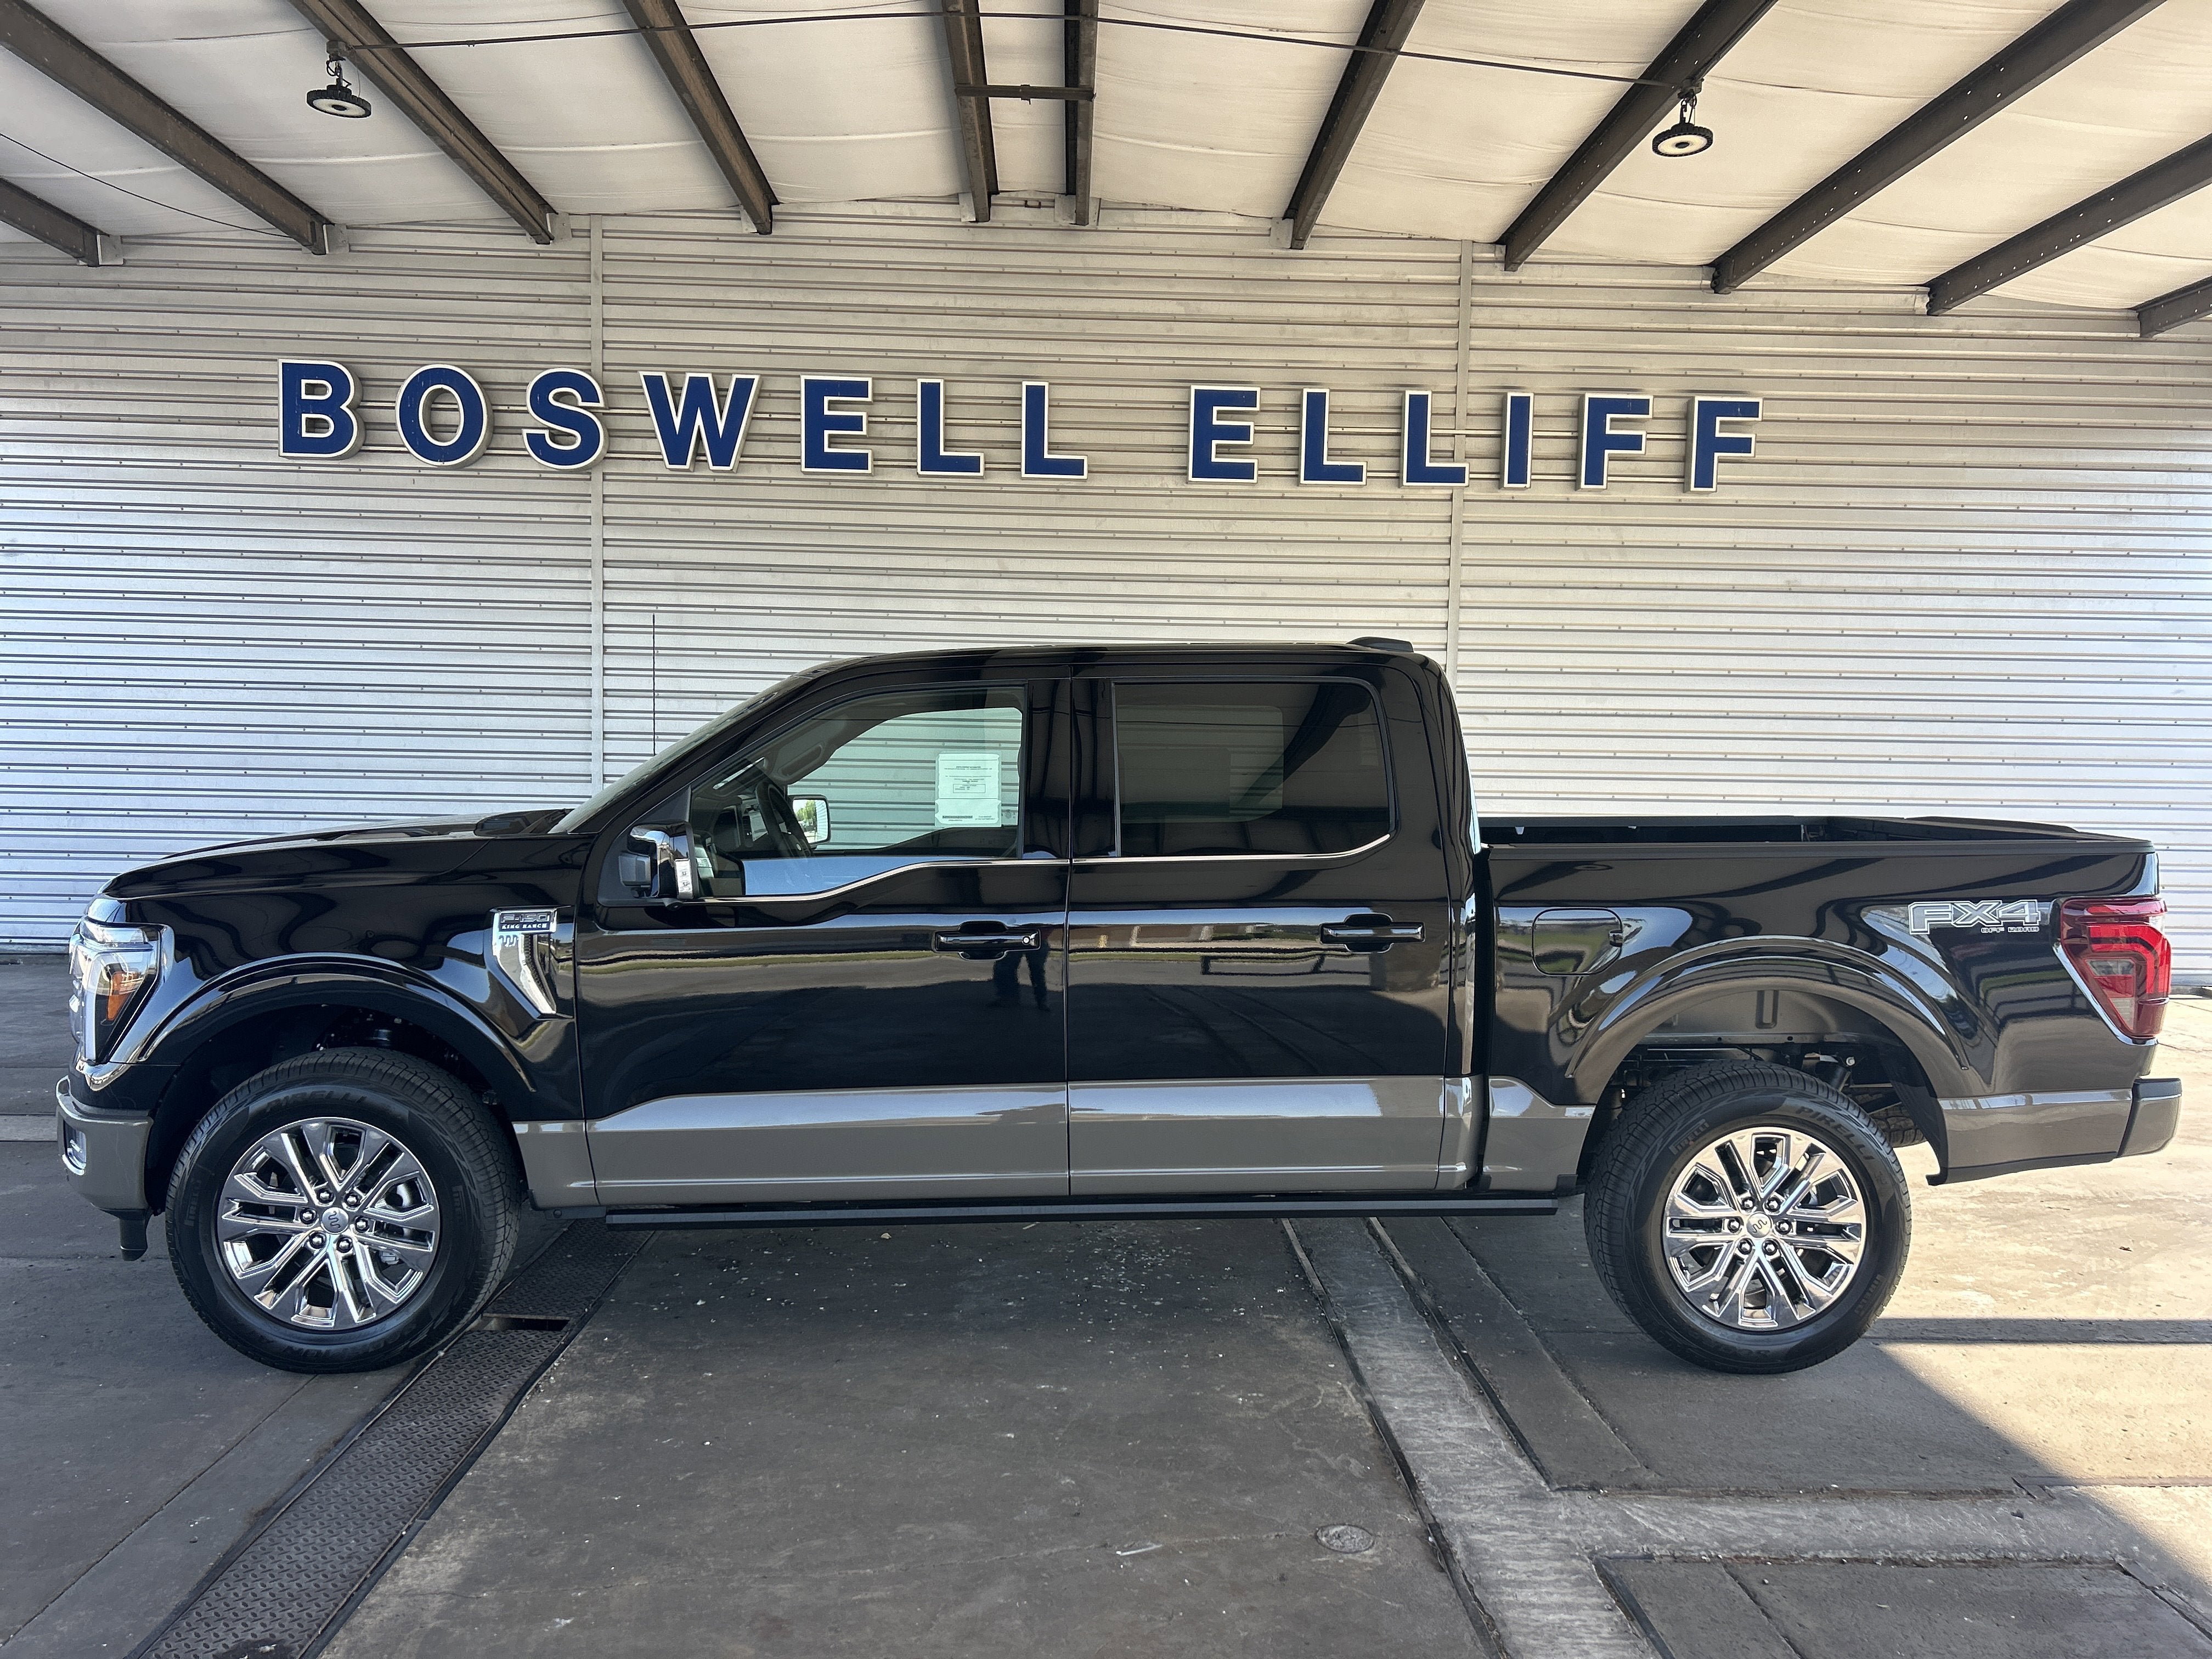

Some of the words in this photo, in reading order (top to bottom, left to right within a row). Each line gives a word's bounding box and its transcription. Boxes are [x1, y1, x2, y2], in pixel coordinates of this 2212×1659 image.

[278, 358, 1088, 480] BOSWELL
[1187, 385, 1763, 493] ELLIFF
[500, 913, 550, 923] F-150
[1908, 899, 2041, 935] FX4
[1796, 1105, 1875, 1160] PIRELLI
